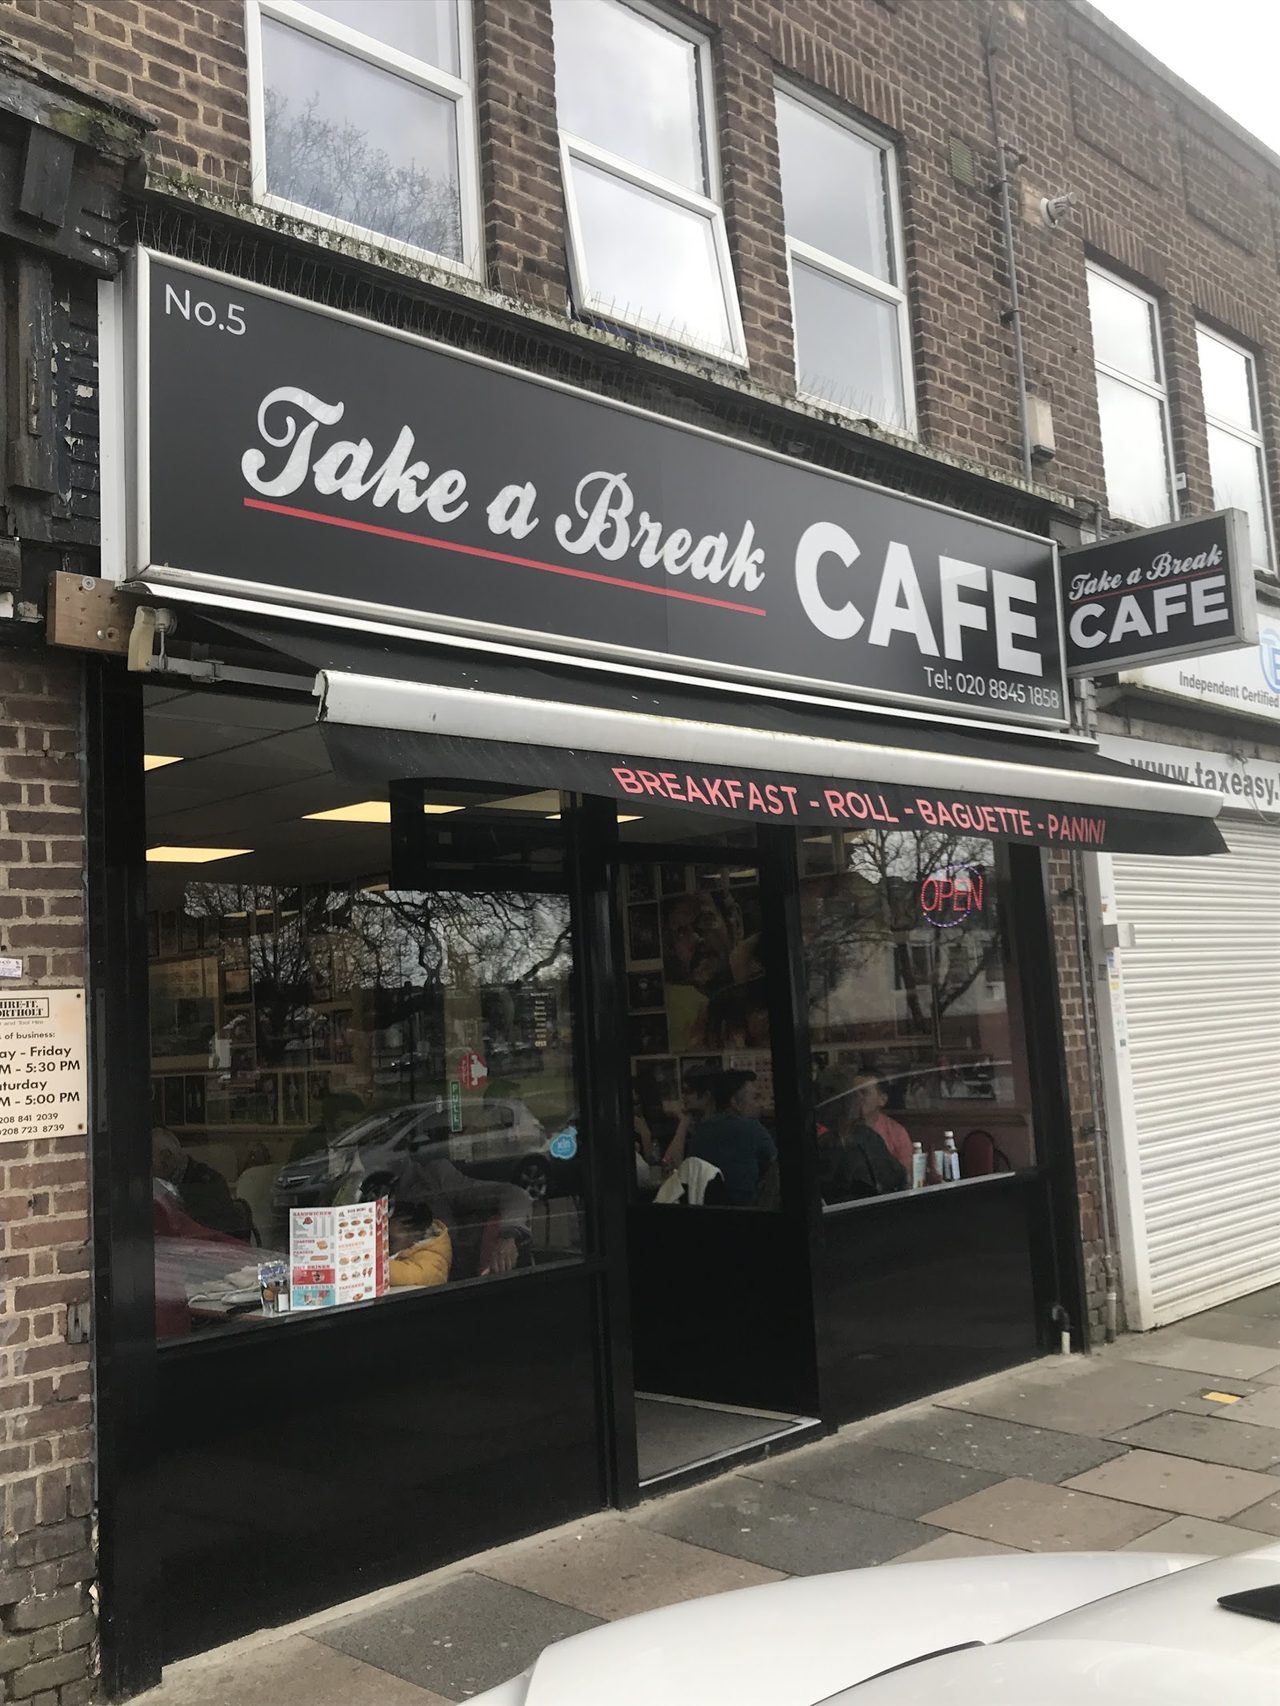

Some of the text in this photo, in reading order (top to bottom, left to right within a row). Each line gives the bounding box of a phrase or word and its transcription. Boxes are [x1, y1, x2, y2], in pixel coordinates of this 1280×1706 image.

[164, 283, 248, 337] No.5
[241, 385, 766, 592] Take a Break
[1068, 543, 1224, 601] Take a Break
[795, 520, 1044, 677] CAFE
[1069, 574, 1230, 650] CAFE
[923, 666, 1060, 709] Tel: 020 8845 1858
[1179, 671, 1280, 709] Independent Certified
[611, 766, 799, 817] BREAKFAST
[823, 790, 900, 824] ROLL
[916, 799, 1034, 838] BAGUETTE
[1047, 813, 1106, 845] PANINI
[920, 876, 984, 912] OPEN
[5, 1032, 13, 1040] of
[17, 1031, 56, 1039] business:
[30, 1045, 72, 1058] Friday
[0, 1079, 48, 1091] turday
[26, 1061, 56, 1073] 5:30
[60, 1060, 81, 1071] PM
[25, 1093, 56, 1105] 5:00
[60, 1091, 80, 1103] PM
[0, 1123, 65, 1136] 208 723 8739
[18, 1115, 32, 1123] 841
[36, 1112, 59, 1121] 2039
